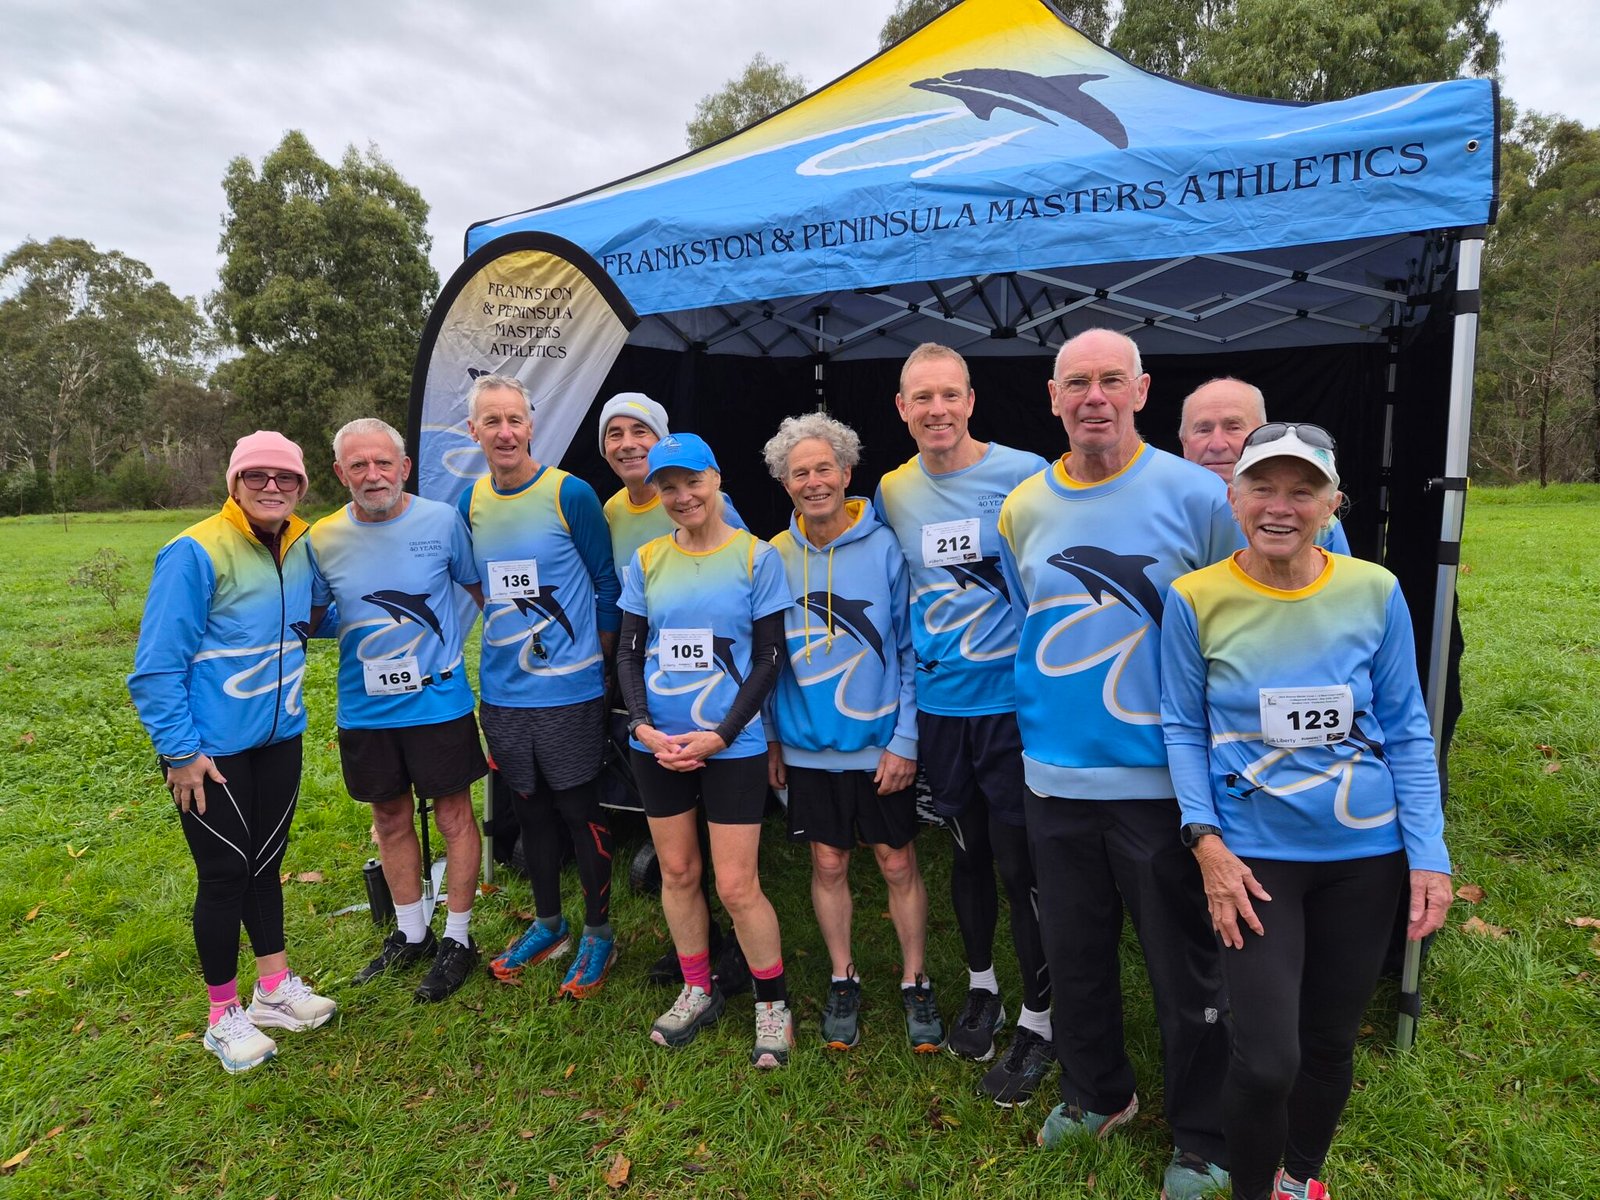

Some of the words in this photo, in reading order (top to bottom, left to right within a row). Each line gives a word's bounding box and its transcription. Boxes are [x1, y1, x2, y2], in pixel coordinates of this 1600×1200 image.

[602, 231, 766, 277] FRANKSTON
[771, 227, 796, 254] &
[802, 202, 978, 251] PENINSULA
[986, 179, 1167, 224] MASTERS
[1177, 141, 1429, 206] ATHLETICS
[488, 281, 573, 300] FRANKSTON
[482, 301, 495, 316] &
[497, 303, 573, 320] PENINSULA
[495, 323, 561, 339] MASTERS
[490, 342, 568, 359] ATHLETICS
[936, 535, 971, 554] 212
[502, 574, 531, 588] 136
[671, 644, 704, 659] 105
[378, 671, 412, 686] 169
[1286, 708, 1340, 731] 123
